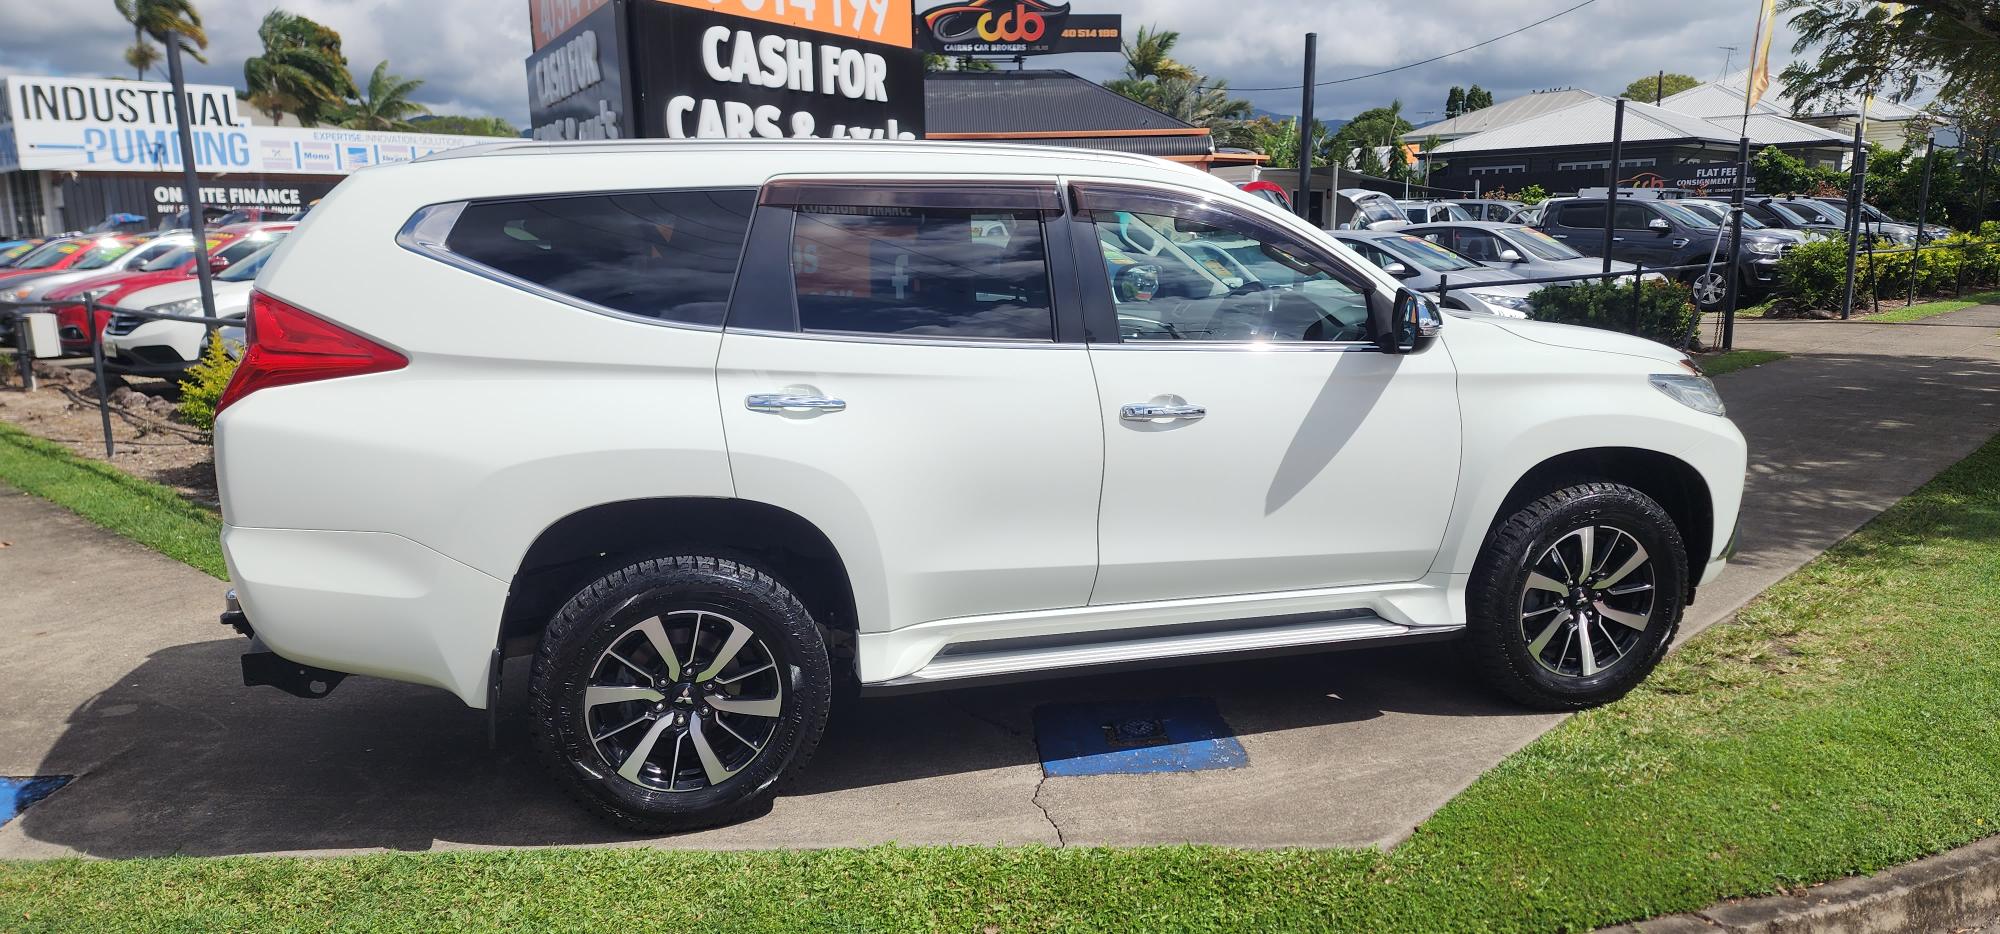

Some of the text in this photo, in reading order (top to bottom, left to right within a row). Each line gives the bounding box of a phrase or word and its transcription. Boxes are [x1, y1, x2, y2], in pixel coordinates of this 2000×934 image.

[1061, 29, 1077, 38] 40
[1078, 29, 1097, 38] 514
[702, 25, 888, 102] CASH FOR
[536, 45, 573, 103] CASH
[666, 95, 784, 139] CARS
[304, 152, 330, 160] Mono
[1696, 167, 1738, 177] FLAT FEE
[1676, 178, 1731, 187] CONSIGNMENT
[154, 187, 300, 205] ON ITE FINANCE
